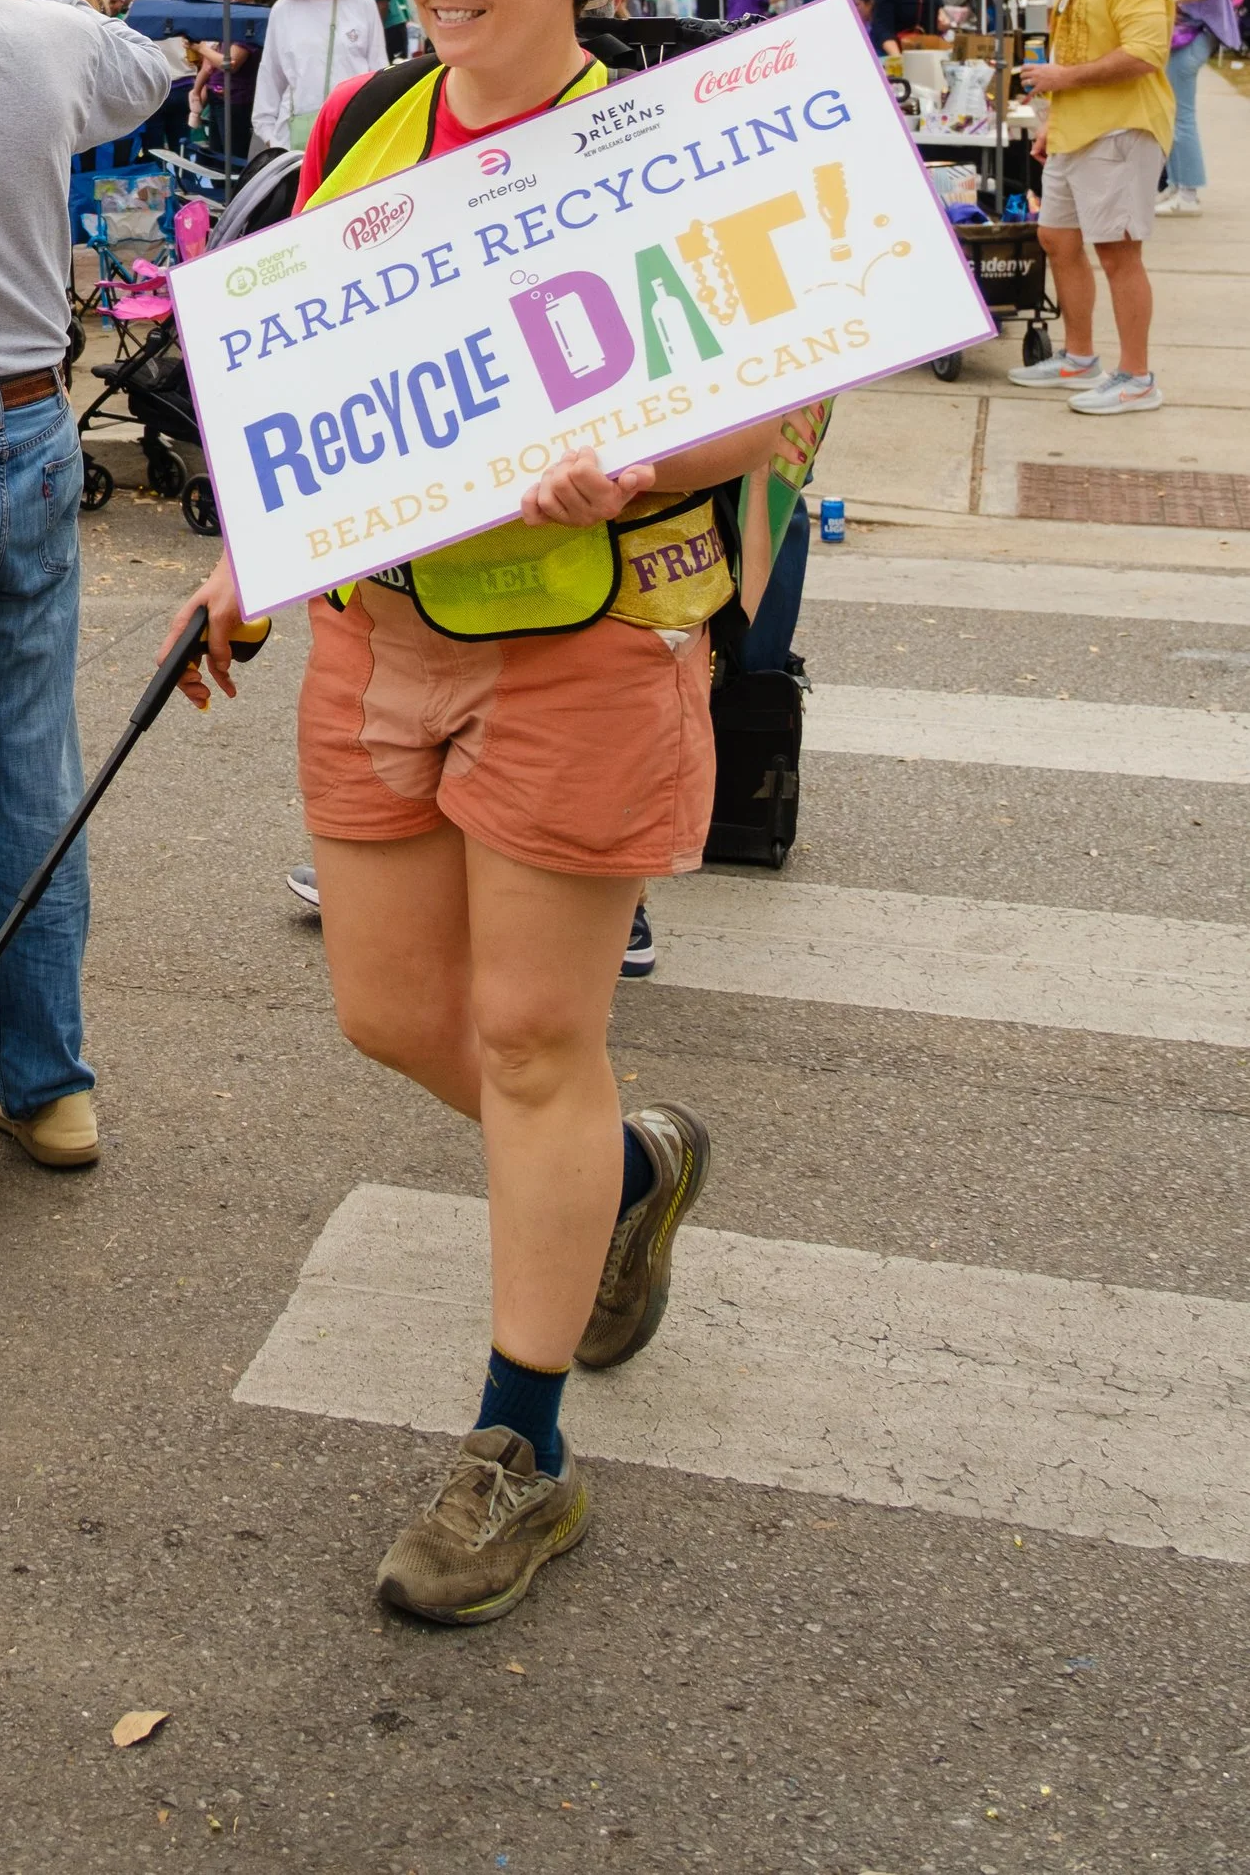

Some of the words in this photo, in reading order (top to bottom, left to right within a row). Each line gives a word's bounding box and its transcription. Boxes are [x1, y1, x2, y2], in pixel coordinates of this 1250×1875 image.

[694, 37, 798, 104] Coca-Cola
[591, 99, 634, 125] NEW
[583, 148, 597, 158] NEW
[597, 137, 624, 153] ORLEANS
[632, 123, 661, 139] COMPANY
[468, 174, 537, 208] entergy
[219, 242, 461, 372] PARADE
[474, 89, 852, 267] RECYCLING
[349, 200, 408, 251] Pepper
[365, 201, 389, 226] Dr
[257, 245, 295, 268] every
[259, 261, 284, 277] can
[261, 261, 307, 286] counts
[305, 482, 449, 560] BEADS
[487, 386, 694, 489] BOTTLES
[736, 319, 871, 387] CANS
